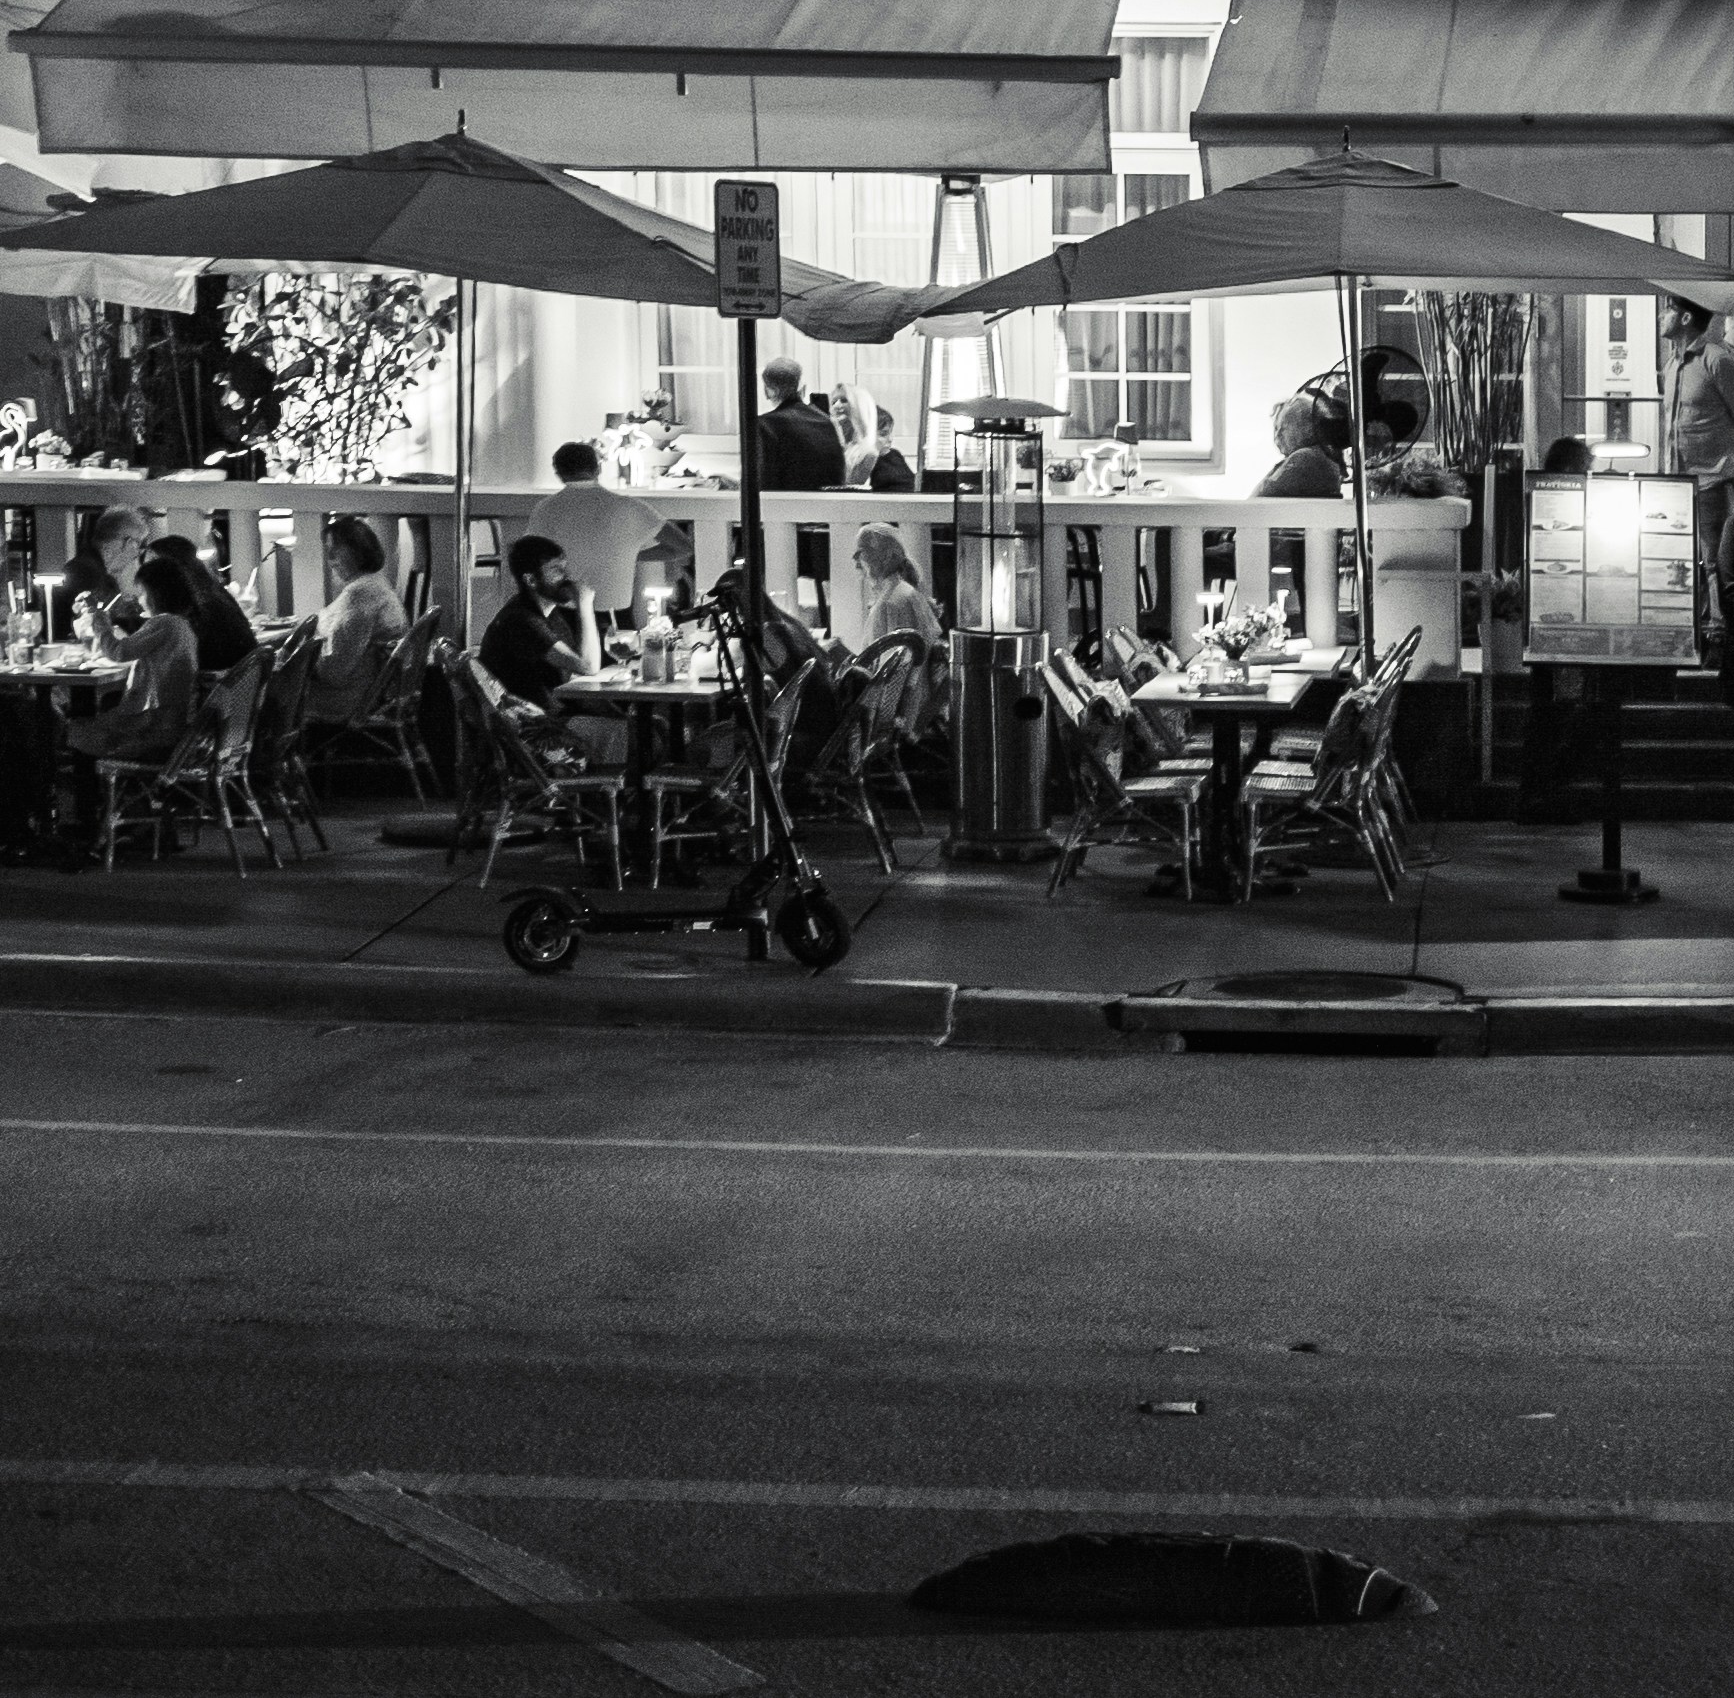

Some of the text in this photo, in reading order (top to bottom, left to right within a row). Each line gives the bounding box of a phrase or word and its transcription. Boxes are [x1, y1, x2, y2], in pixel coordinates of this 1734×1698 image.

[735, 188, 759, 213] NO
[720, 216, 774, 242] PARKING
[737, 246, 758, 263] ANY
[737, 266, 760, 284] TIME
